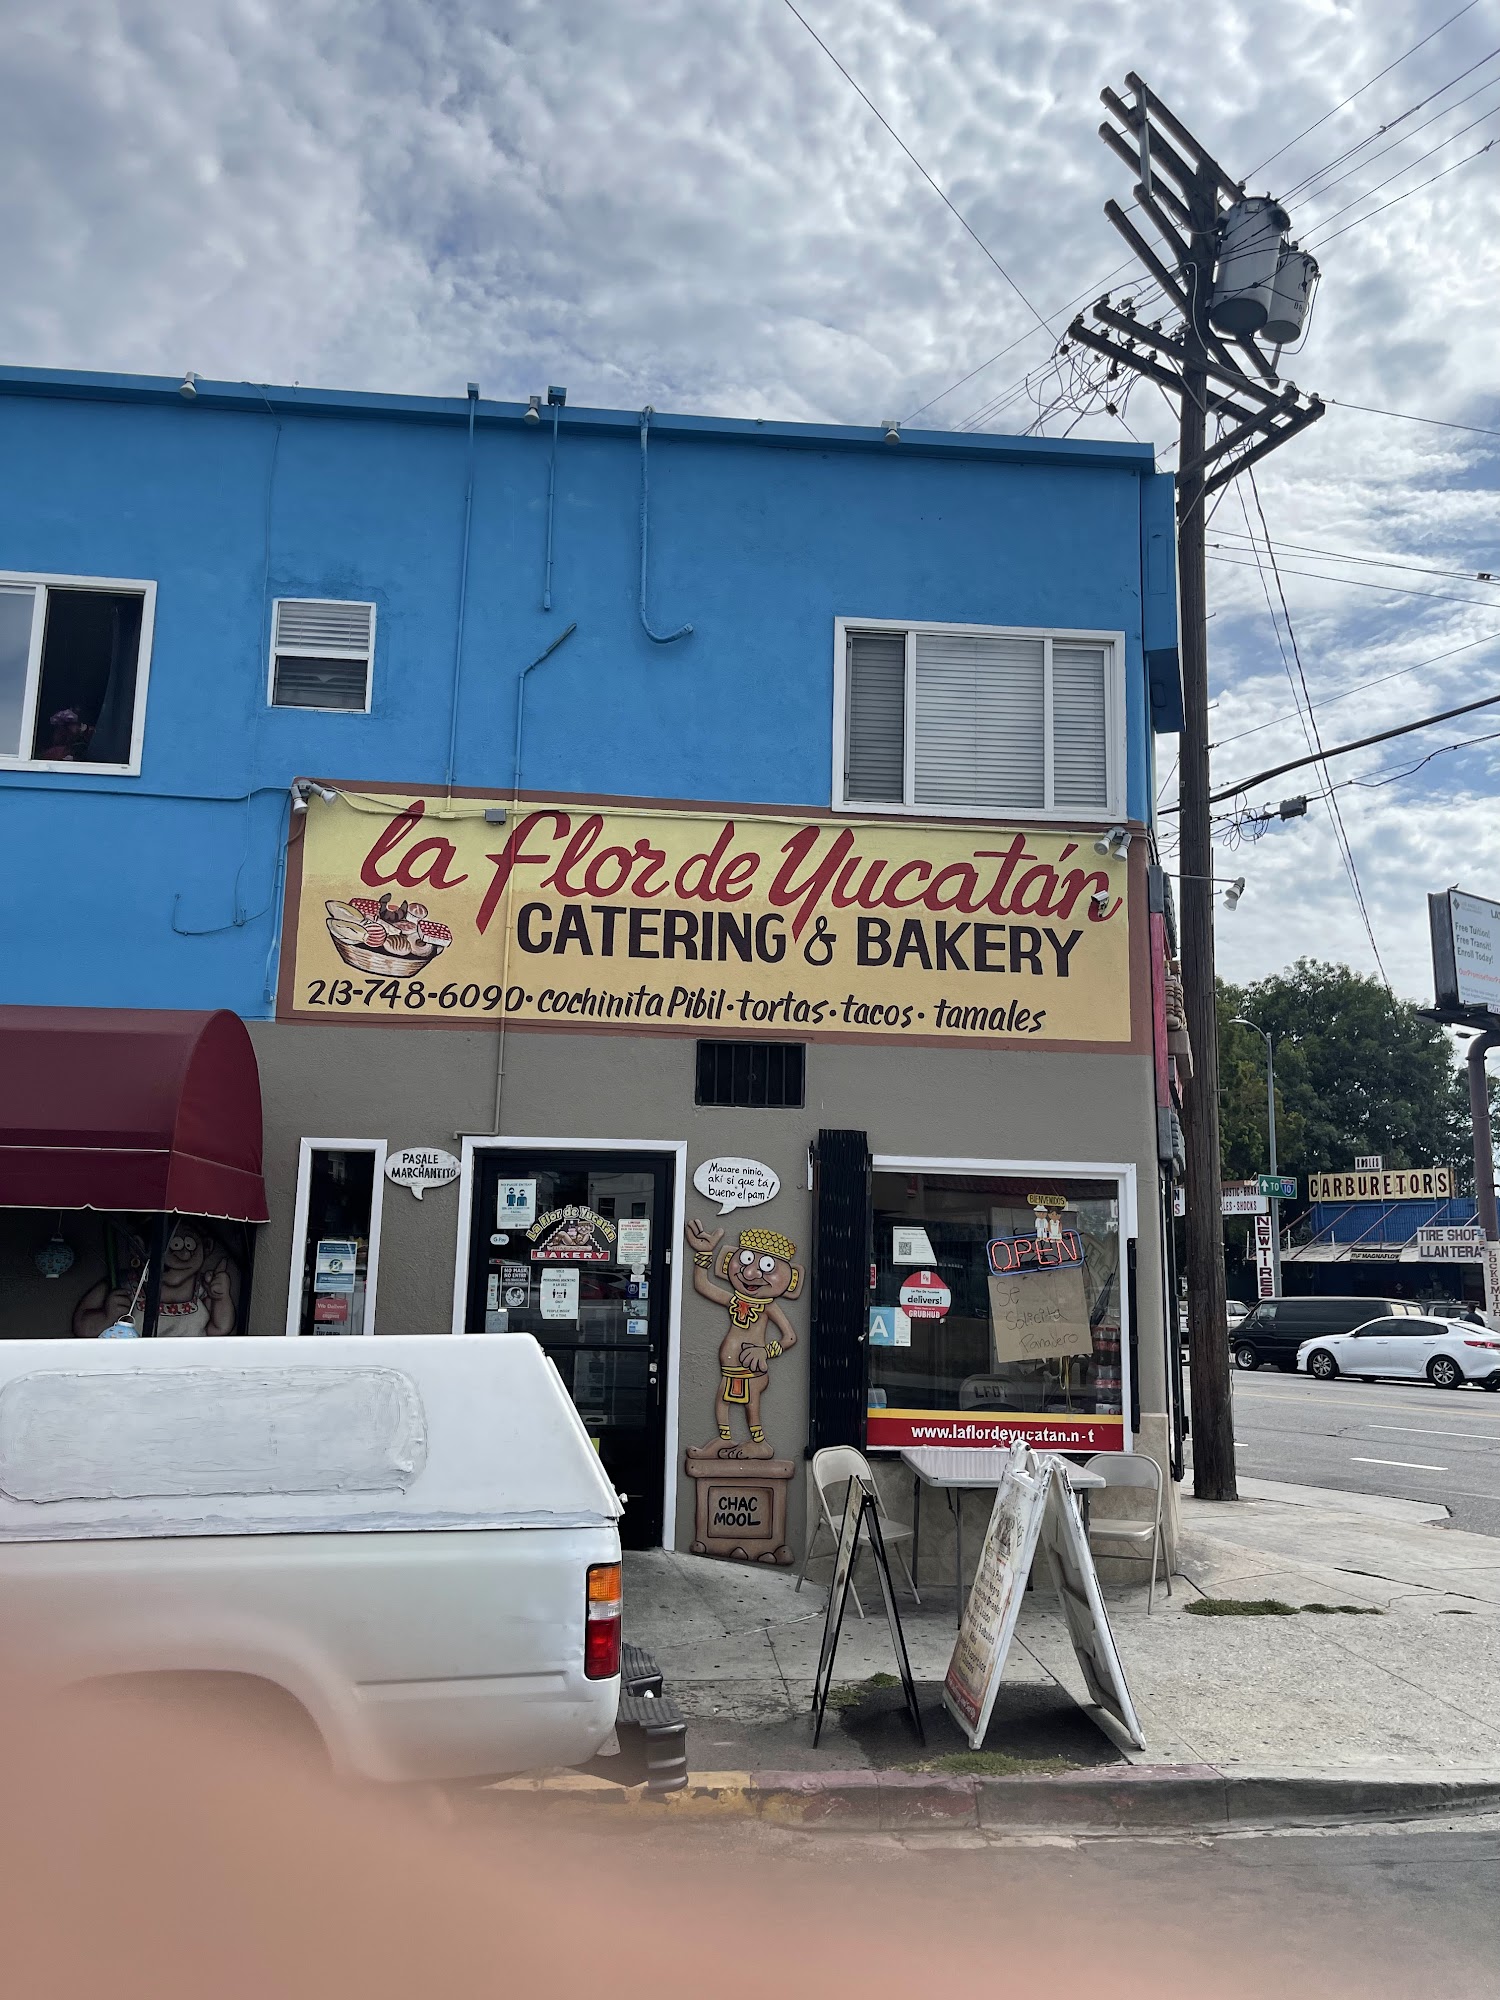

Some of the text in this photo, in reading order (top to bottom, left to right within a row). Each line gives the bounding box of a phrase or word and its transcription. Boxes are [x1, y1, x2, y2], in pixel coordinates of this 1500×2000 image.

[360, 799, 468, 889] la
[674, 820, 760, 903] de
[768, 825, 1123, 943] Yucatán
[1455, 921, 1469, 933] Free
[517, 902, 1084, 978] CATERING & BAKERY
[1456, 934, 1470, 945] Free
[1457, 946, 1494, 965] Enroll Today!
[307, 979, 1047, 1033] 213-748-6090 cochinita Pibil tortas tacos tamales
[402, 1153, 439, 1165] PASALE
[391, 1167, 457, 1179] MARCHANTITO
[708, 1162, 740, 1174] Maaare
[738, 1178, 755, 1189] que
[1270, 1182, 1292, 1194] TO 10
[1310, 1172, 1447, 1198] CARBURETORS
[708, 1185, 736, 1198] bueno
[737, 1187, 746, 1199] el
[1029, 1194, 1065, 1205] BIENVENIDOS
[1236, 1200, 1257, 1211] SHOCKS
[526, 1223, 544, 1242] La
[538, 1208, 563, 1229] Flor
[563, 1204, 580, 1218] de
[579, 1206, 617, 1243] Yucatán
[1418, 1229, 1444, 1241] TIRE
[536, 1251, 605, 1259] BAKERY
[992, 1232, 1077, 1271] OPEN
[1420, 1245, 1482, 1258] LLANTERA
[907, 1294, 943, 1305] delivers!
[996, 1282, 1020, 1307] Se
[908, 1309, 941, 1319] GRUBHUB
[869, 1315, 889, 1338] A
[911, 1423, 1095, 1444] www.laflordeyucatan.nt
[718, 1496, 758, 1512] CHAC
[713, 1512, 761, 1526] MOOL
